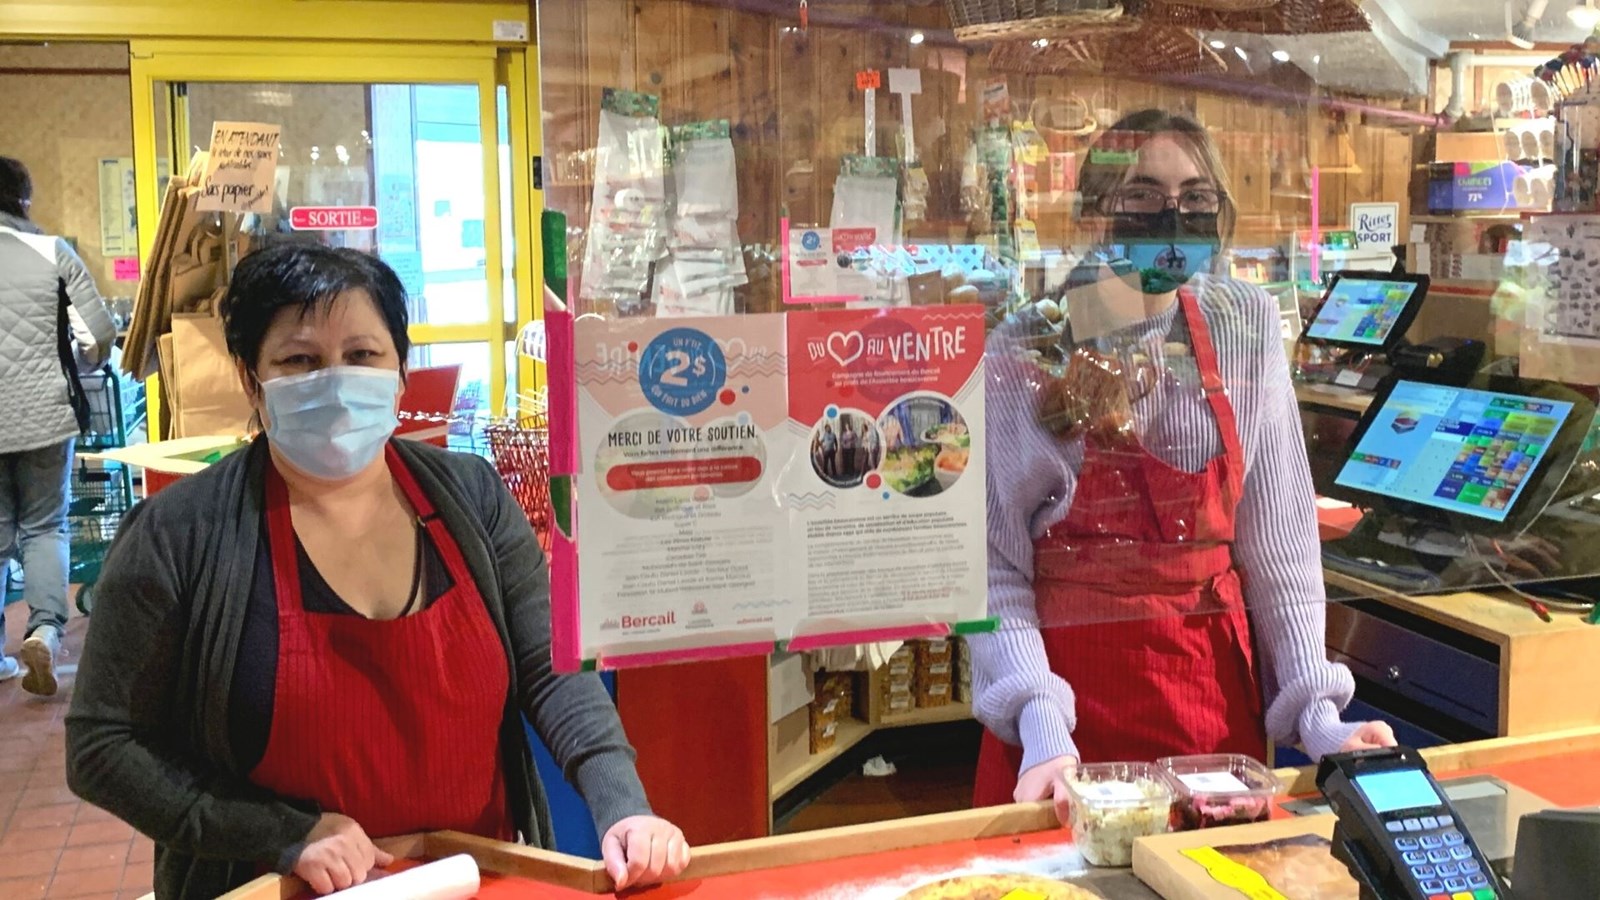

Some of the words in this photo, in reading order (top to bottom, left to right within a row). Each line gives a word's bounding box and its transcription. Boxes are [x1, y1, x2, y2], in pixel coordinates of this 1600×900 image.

[228, 131, 279, 147] ATTENDANT
[221, 184, 255, 204] papier
[308, 210, 362, 226] SORTIE
[1358, 213, 1392, 232] Ritter
[1357, 232, 1391, 244] SPORT
[808, 341, 826, 361] DU
[866, 338, 884, 356] AU
[888, 326, 966, 364] VENTRE
[660, 350, 706, 387] 2$
[608, 432, 642, 448] MERCI
[648, 430, 662, 444] DE
[666, 427, 702, 444] VOTRE
[708, 424, 758, 442] SOUTIEN.
[622, 611, 676, 628] Bercail
